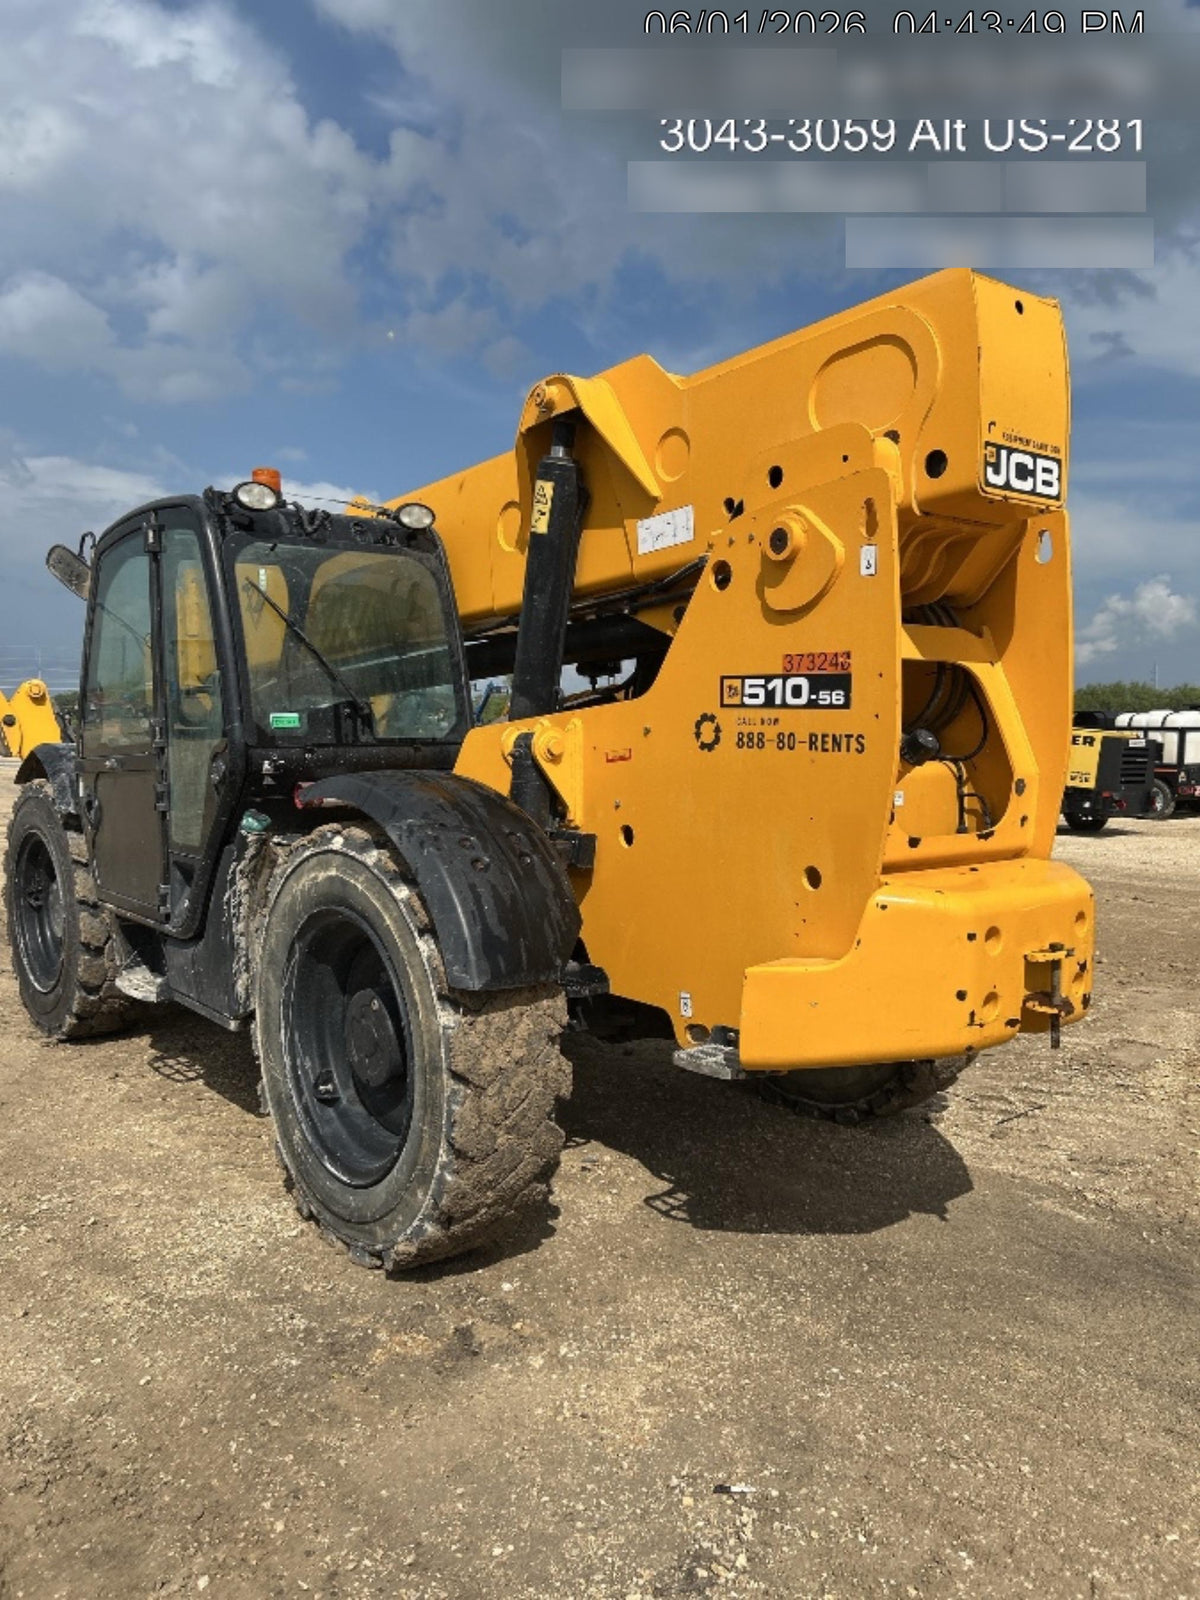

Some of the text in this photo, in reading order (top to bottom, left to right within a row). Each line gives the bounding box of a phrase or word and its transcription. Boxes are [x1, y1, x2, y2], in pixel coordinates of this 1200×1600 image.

[986, 449, 1060, 497] JCB
[742, 677, 846, 706] 510-56
[736, 731, 866, 754] 888-80-RENTS
